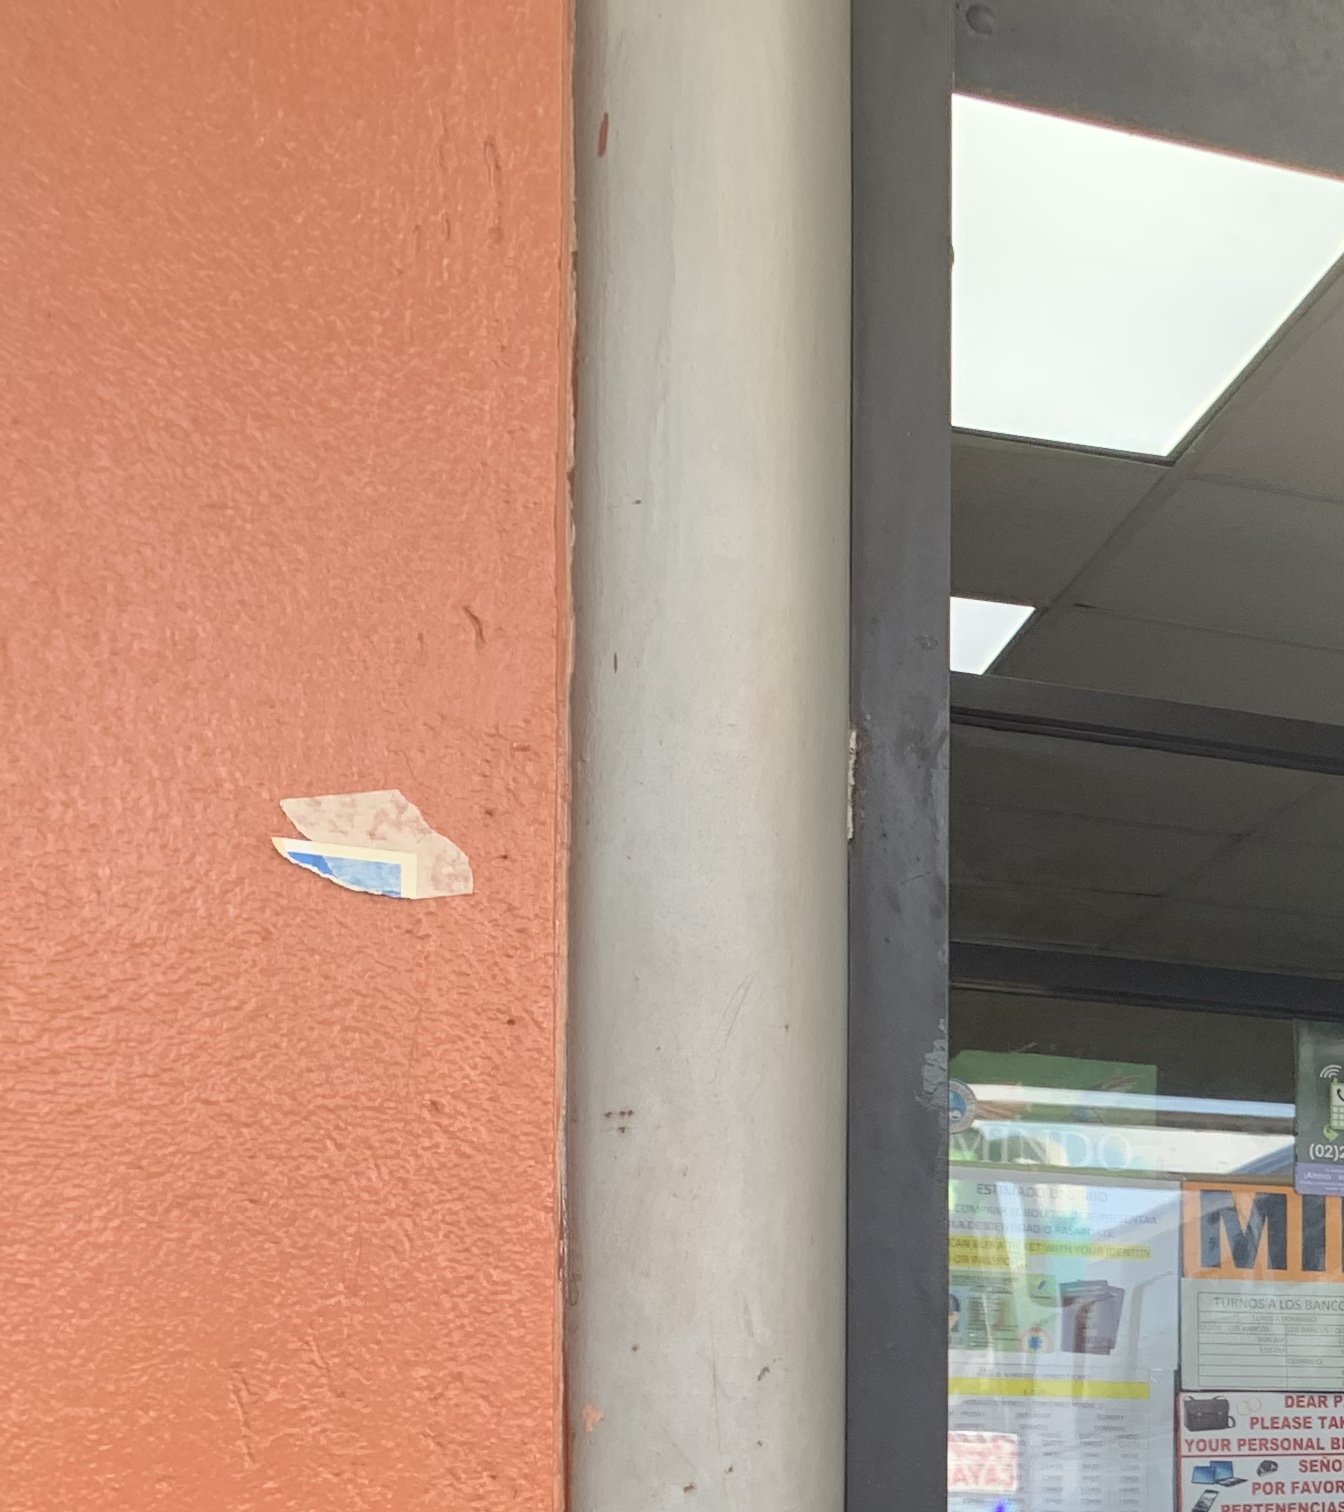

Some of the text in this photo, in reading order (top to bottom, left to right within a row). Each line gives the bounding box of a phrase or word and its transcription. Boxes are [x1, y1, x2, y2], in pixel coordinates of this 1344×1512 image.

[1214, 1297, 1265, 1309] TURNOS
[1269, 1299, 1276, 1309] A
[1279, 1299, 1301, 1310] LOS
[1284, 1395, 1329, 1408] DEAR
[1250, 1416, 1312, 1429] PLEASE
[1184, 1438, 1231, 1452] YOUR
[1237, 1437, 1324, 1451] PERSONAL
[1252, 1482, 1285, 1495] POR
